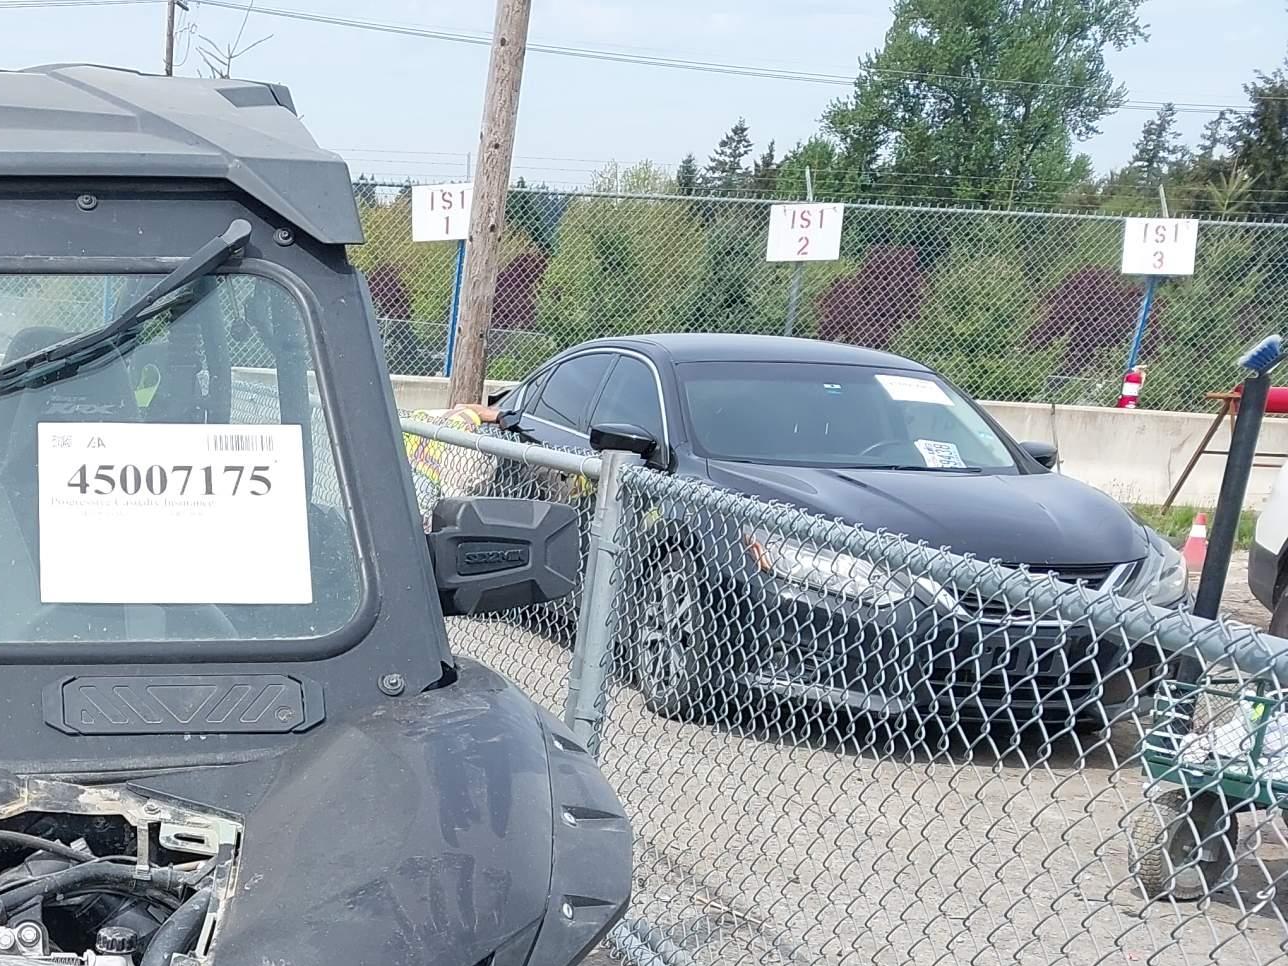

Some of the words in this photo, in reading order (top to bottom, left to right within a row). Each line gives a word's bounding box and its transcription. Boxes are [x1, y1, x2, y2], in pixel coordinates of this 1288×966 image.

[796, 235, 811, 257] 2
[1151, 250, 1165, 270] 3
[67, 463, 273, 497] 45007175
